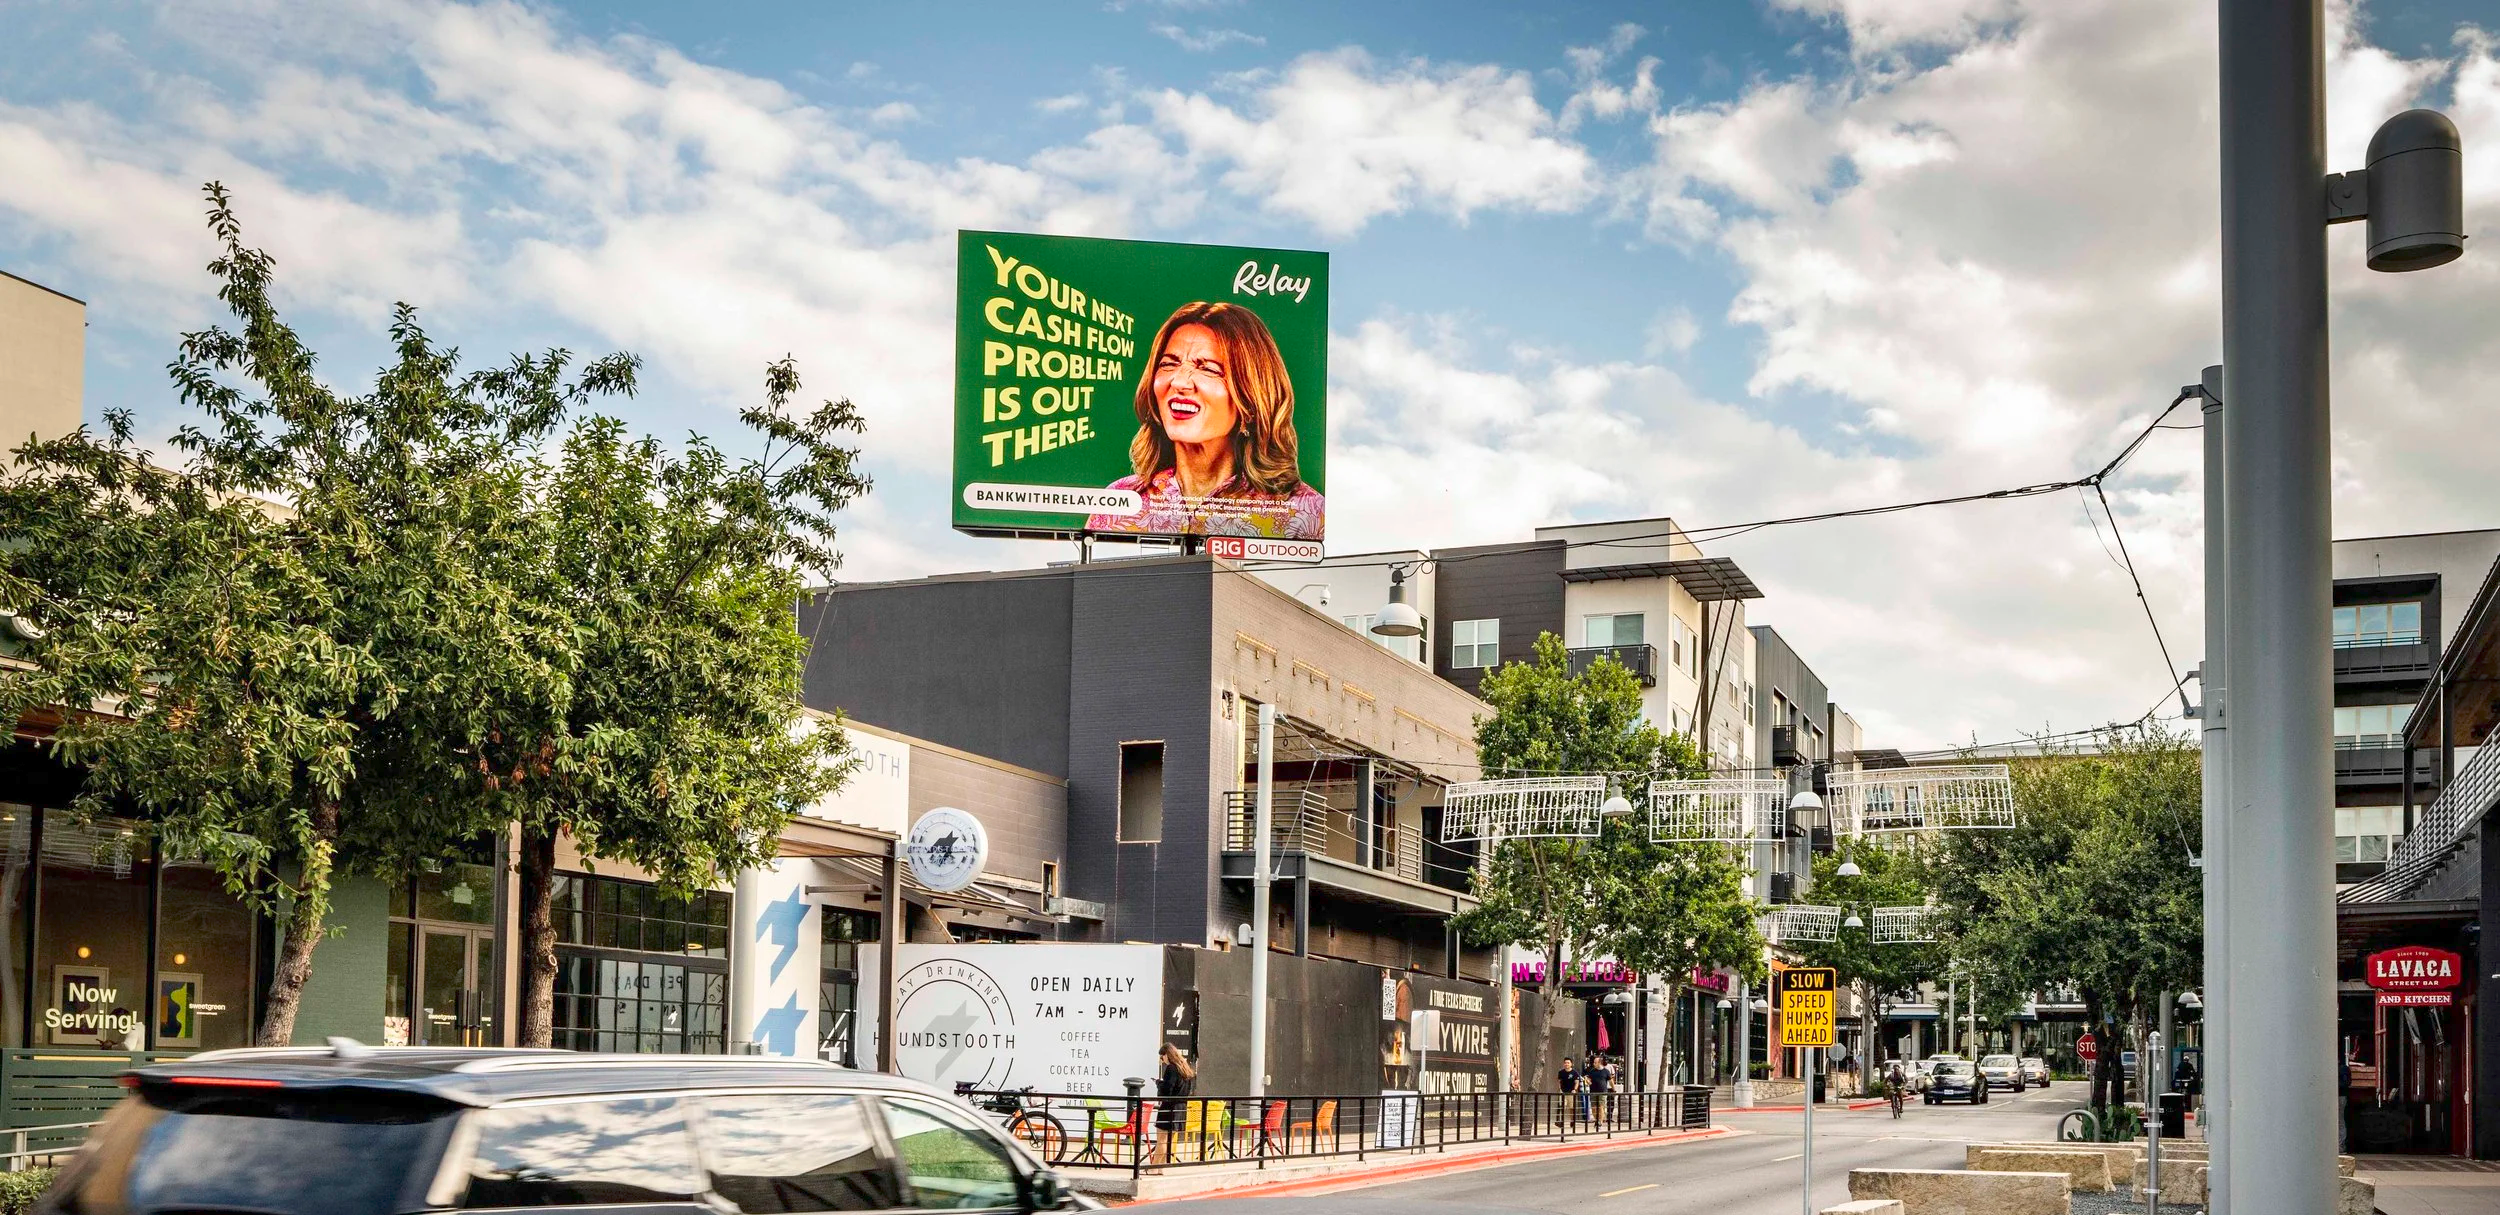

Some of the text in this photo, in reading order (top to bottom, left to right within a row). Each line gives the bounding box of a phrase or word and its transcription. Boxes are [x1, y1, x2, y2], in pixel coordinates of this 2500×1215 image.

[985, 244, 1135, 335] YOUR NEXT
[1233, 260, 1312, 303] Relay
[984, 296, 1135, 358] CASH FLOW
[984, 340, 1123, 381] PROBLEM
[983, 386, 1094, 423] IS OUT
[982, 415, 1096, 468] THERE.
[977, 490, 1130, 508] BANKWITHRELAY.COM
[1203, 496, 1235, 504] technology
[1262, 506, 1289, 514] provided
[1211, 540, 1319, 558] BIG OUTDOOR
[2376, 959, 2452, 978] LAVACA
[926, 966, 1000, 1006] DRINKING
[1031, 977, 1135, 993] OPEN DAILY
[1790, 973, 1825, 988] SLOW
[68, 982, 117, 1004] Now
[1429, 989, 1483, 1013] A TRUE TEXAS EXPERIENCE
[1789, 994, 1826, 1008] SPEED
[2379, 995, 2450, 1004] AND KITCHEN
[189, 1003, 226, 1011] sweetgreen
[1035, 1004, 1065, 1018] 7AM
[1098, 1006, 1129, 1019] 9PM
[45, 1008, 138, 1035] Serving!
[1786, 1011, 1829, 1025] HUMPS
[873, 1031, 1015, 1049] HUNDSTOOTH
[1060, 1031, 1101, 1042] COFFEE
[1440, 1021, 1490, 1056] YWIRE
[1786, 1028, 1827, 1042] AHEAD
[1071, 1049, 1090, 1059] TEA
[2079, 1041, 2097, 1053] STO
[1049, 1065, 1110, 1076] COCKTAILS
[1066, 1082, 1093, 1093] BEER
[1452, 1072, 1471, 1100] SOON
[1065, 1099, 1087, 1107] WIN
